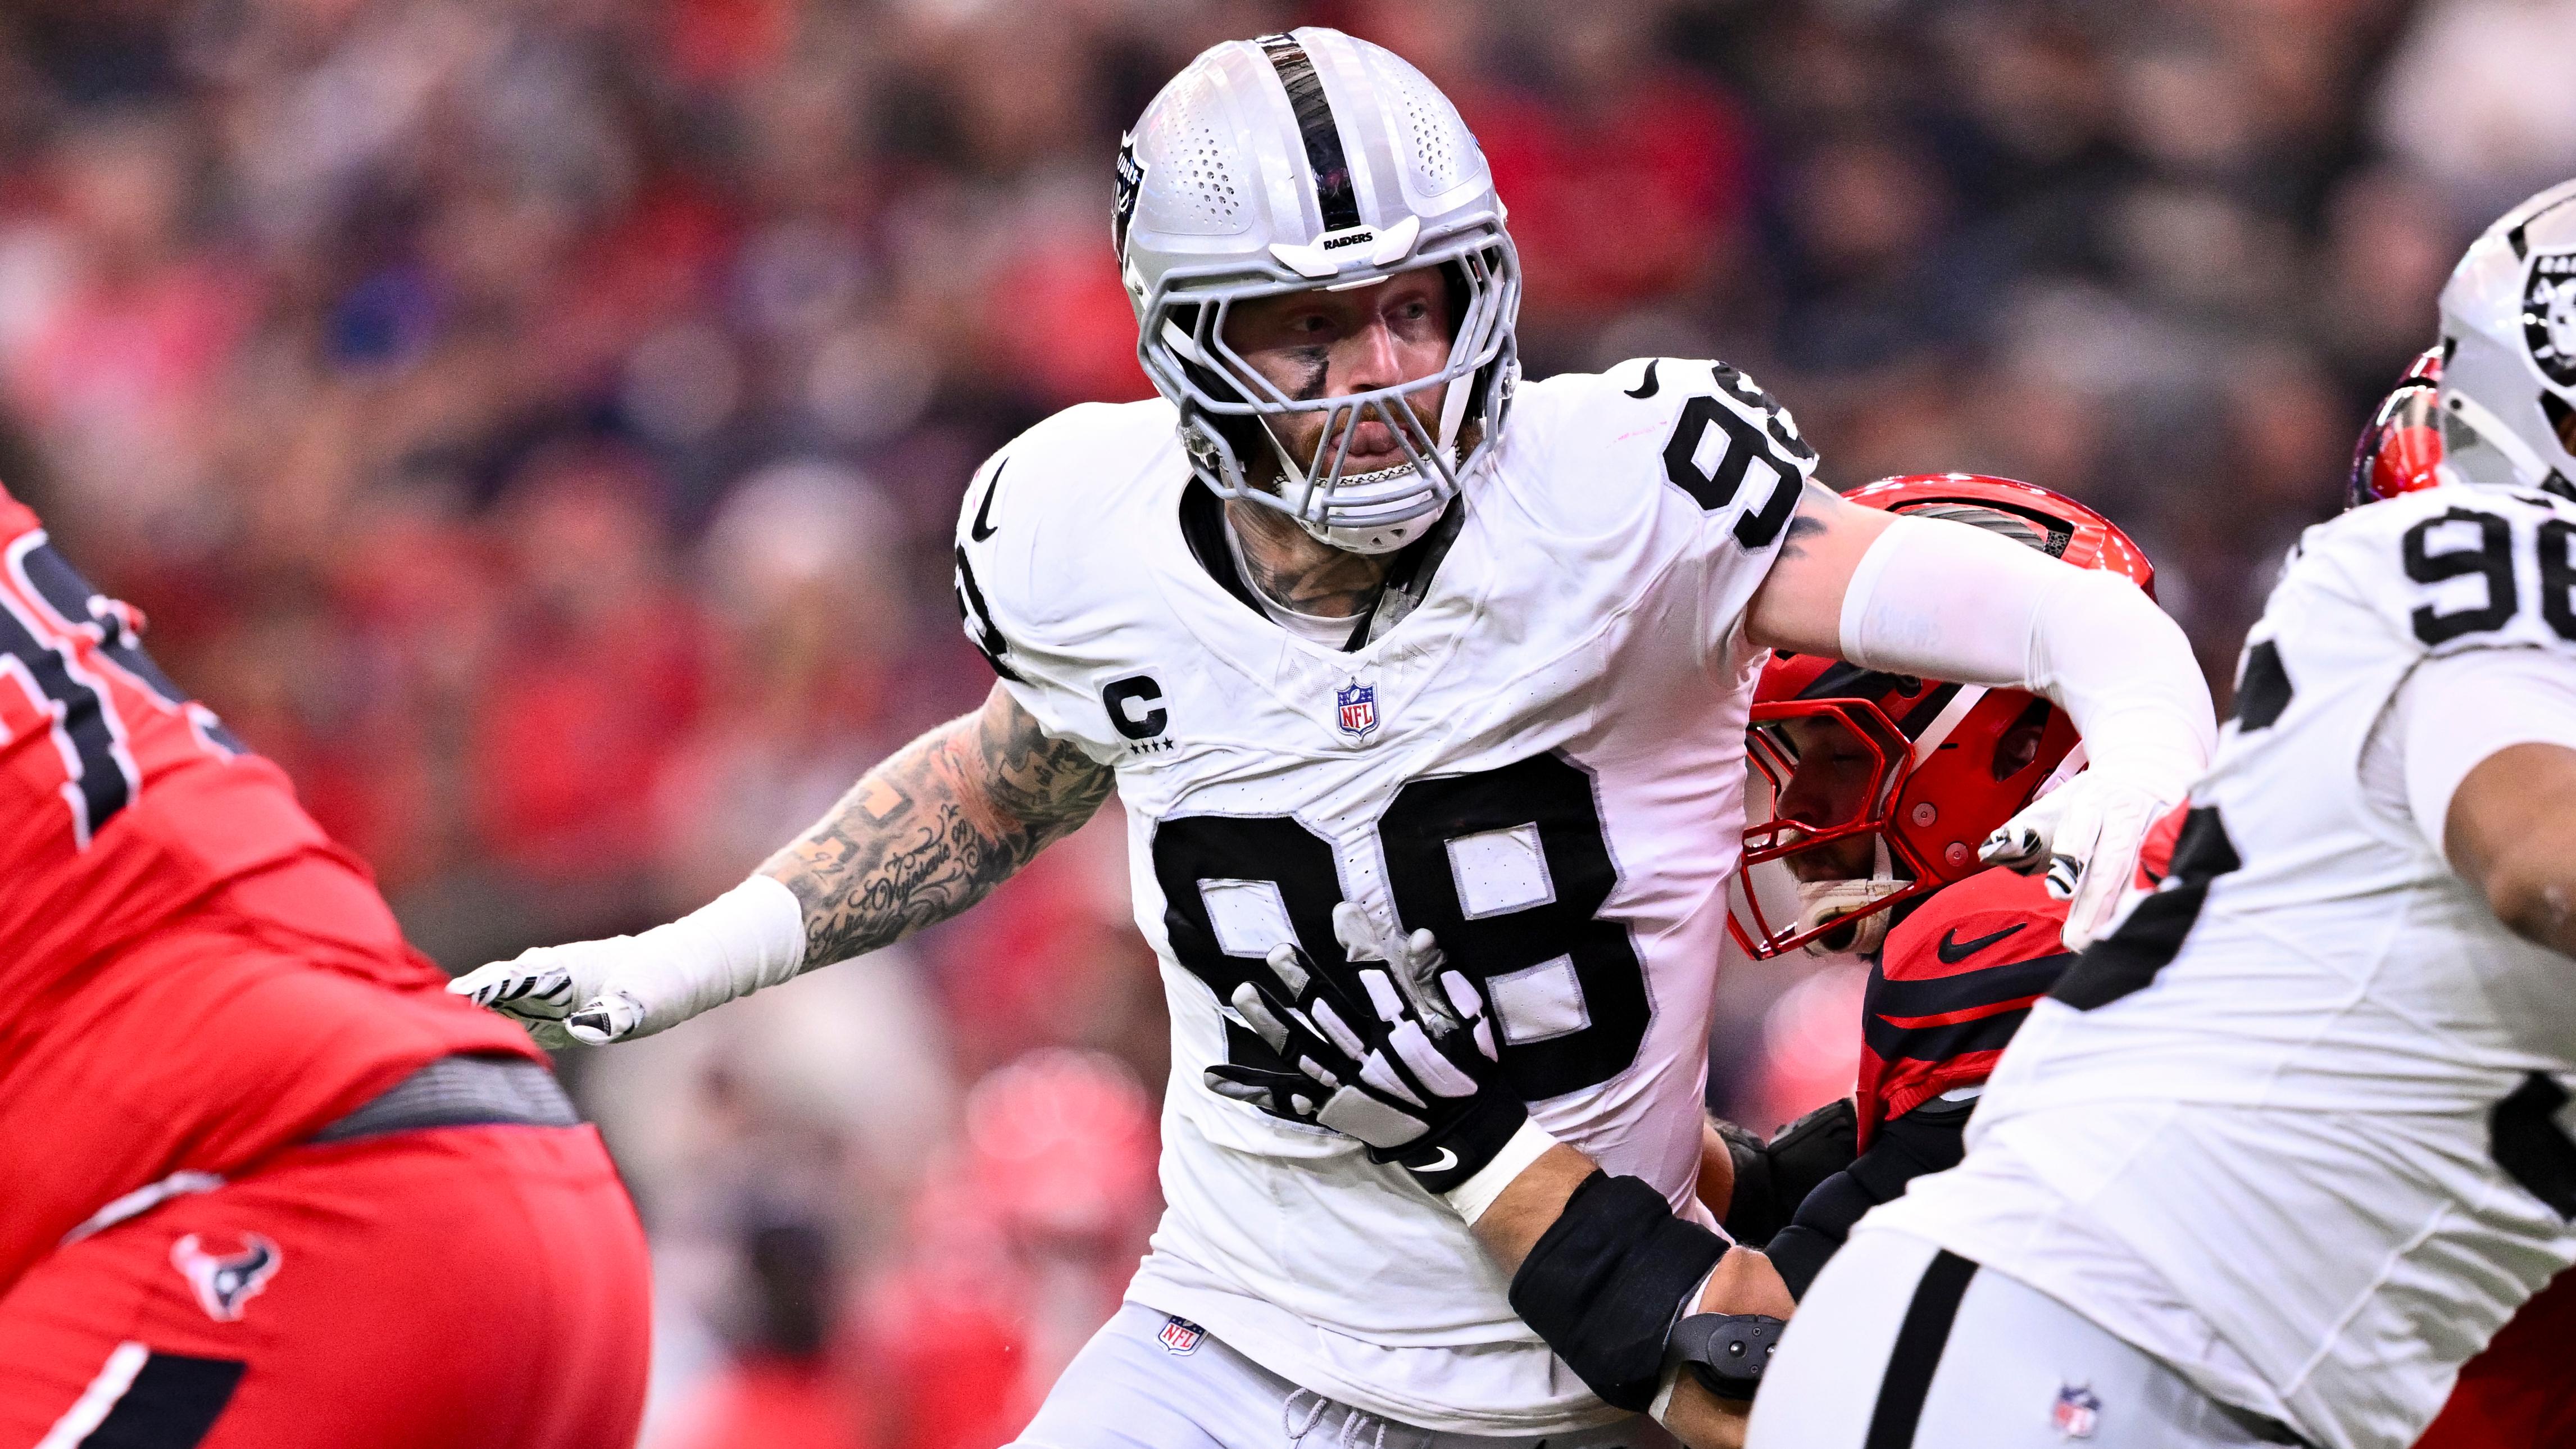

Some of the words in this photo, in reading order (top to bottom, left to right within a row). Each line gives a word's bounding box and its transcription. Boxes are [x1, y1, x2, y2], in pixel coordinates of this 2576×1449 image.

[1323, 232, 1373, 251] RAIDERS
[1102, 675, 1168, 740] C
[1341, 704, 1373, 729] NFL
[1151, 751, 1655, 1136] 98
[1162, 1324, 1194, 1347] NFL
